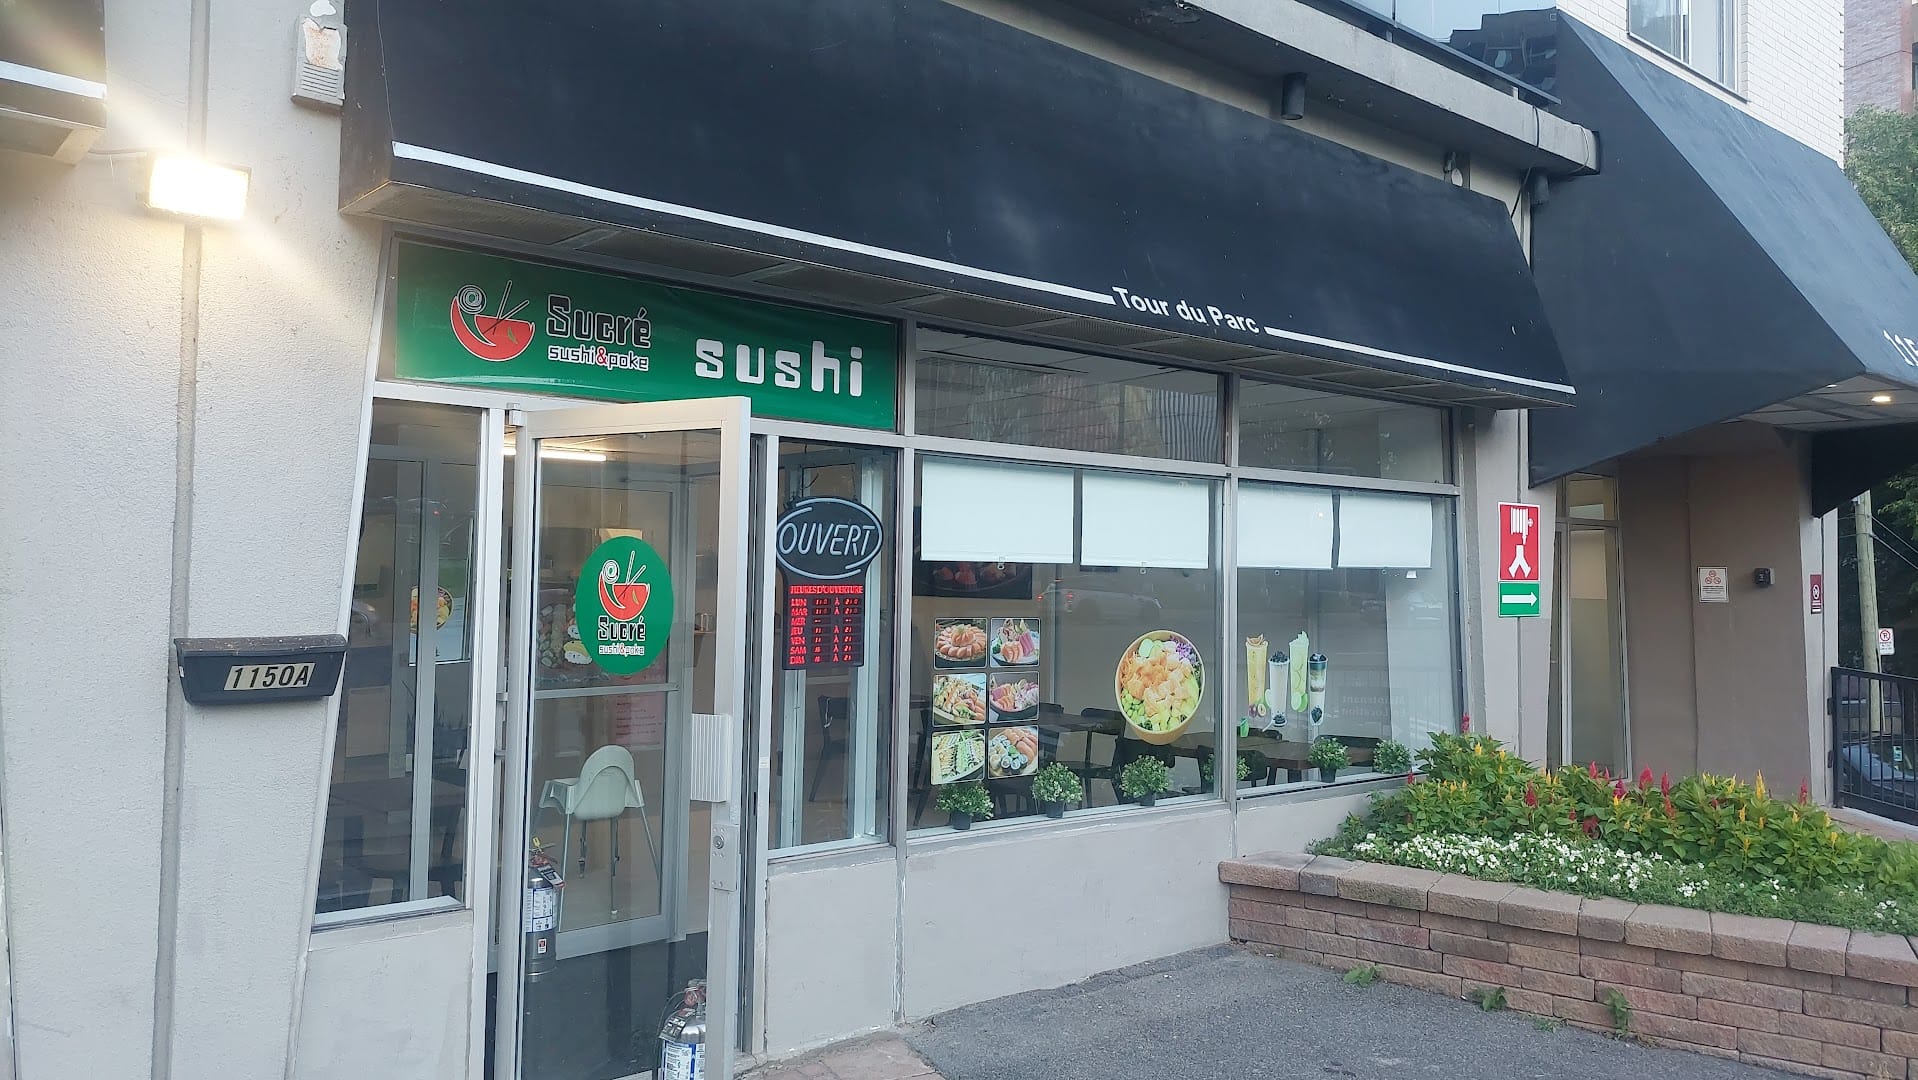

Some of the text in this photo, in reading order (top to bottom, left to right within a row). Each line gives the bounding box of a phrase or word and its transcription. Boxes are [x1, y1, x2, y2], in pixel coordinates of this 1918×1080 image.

[546, 293, 651, 348] Sucré
[1112, 286, 1260, 333] Tour du Parc
[548, 344, 649, 371] sushi&poke
[695, 338, 863, 397] sushi
[779, 522, 876, 556] OUVERT
[598, 615, 646, 641] Sucré
[232, 665, 310, 689] 1150A
